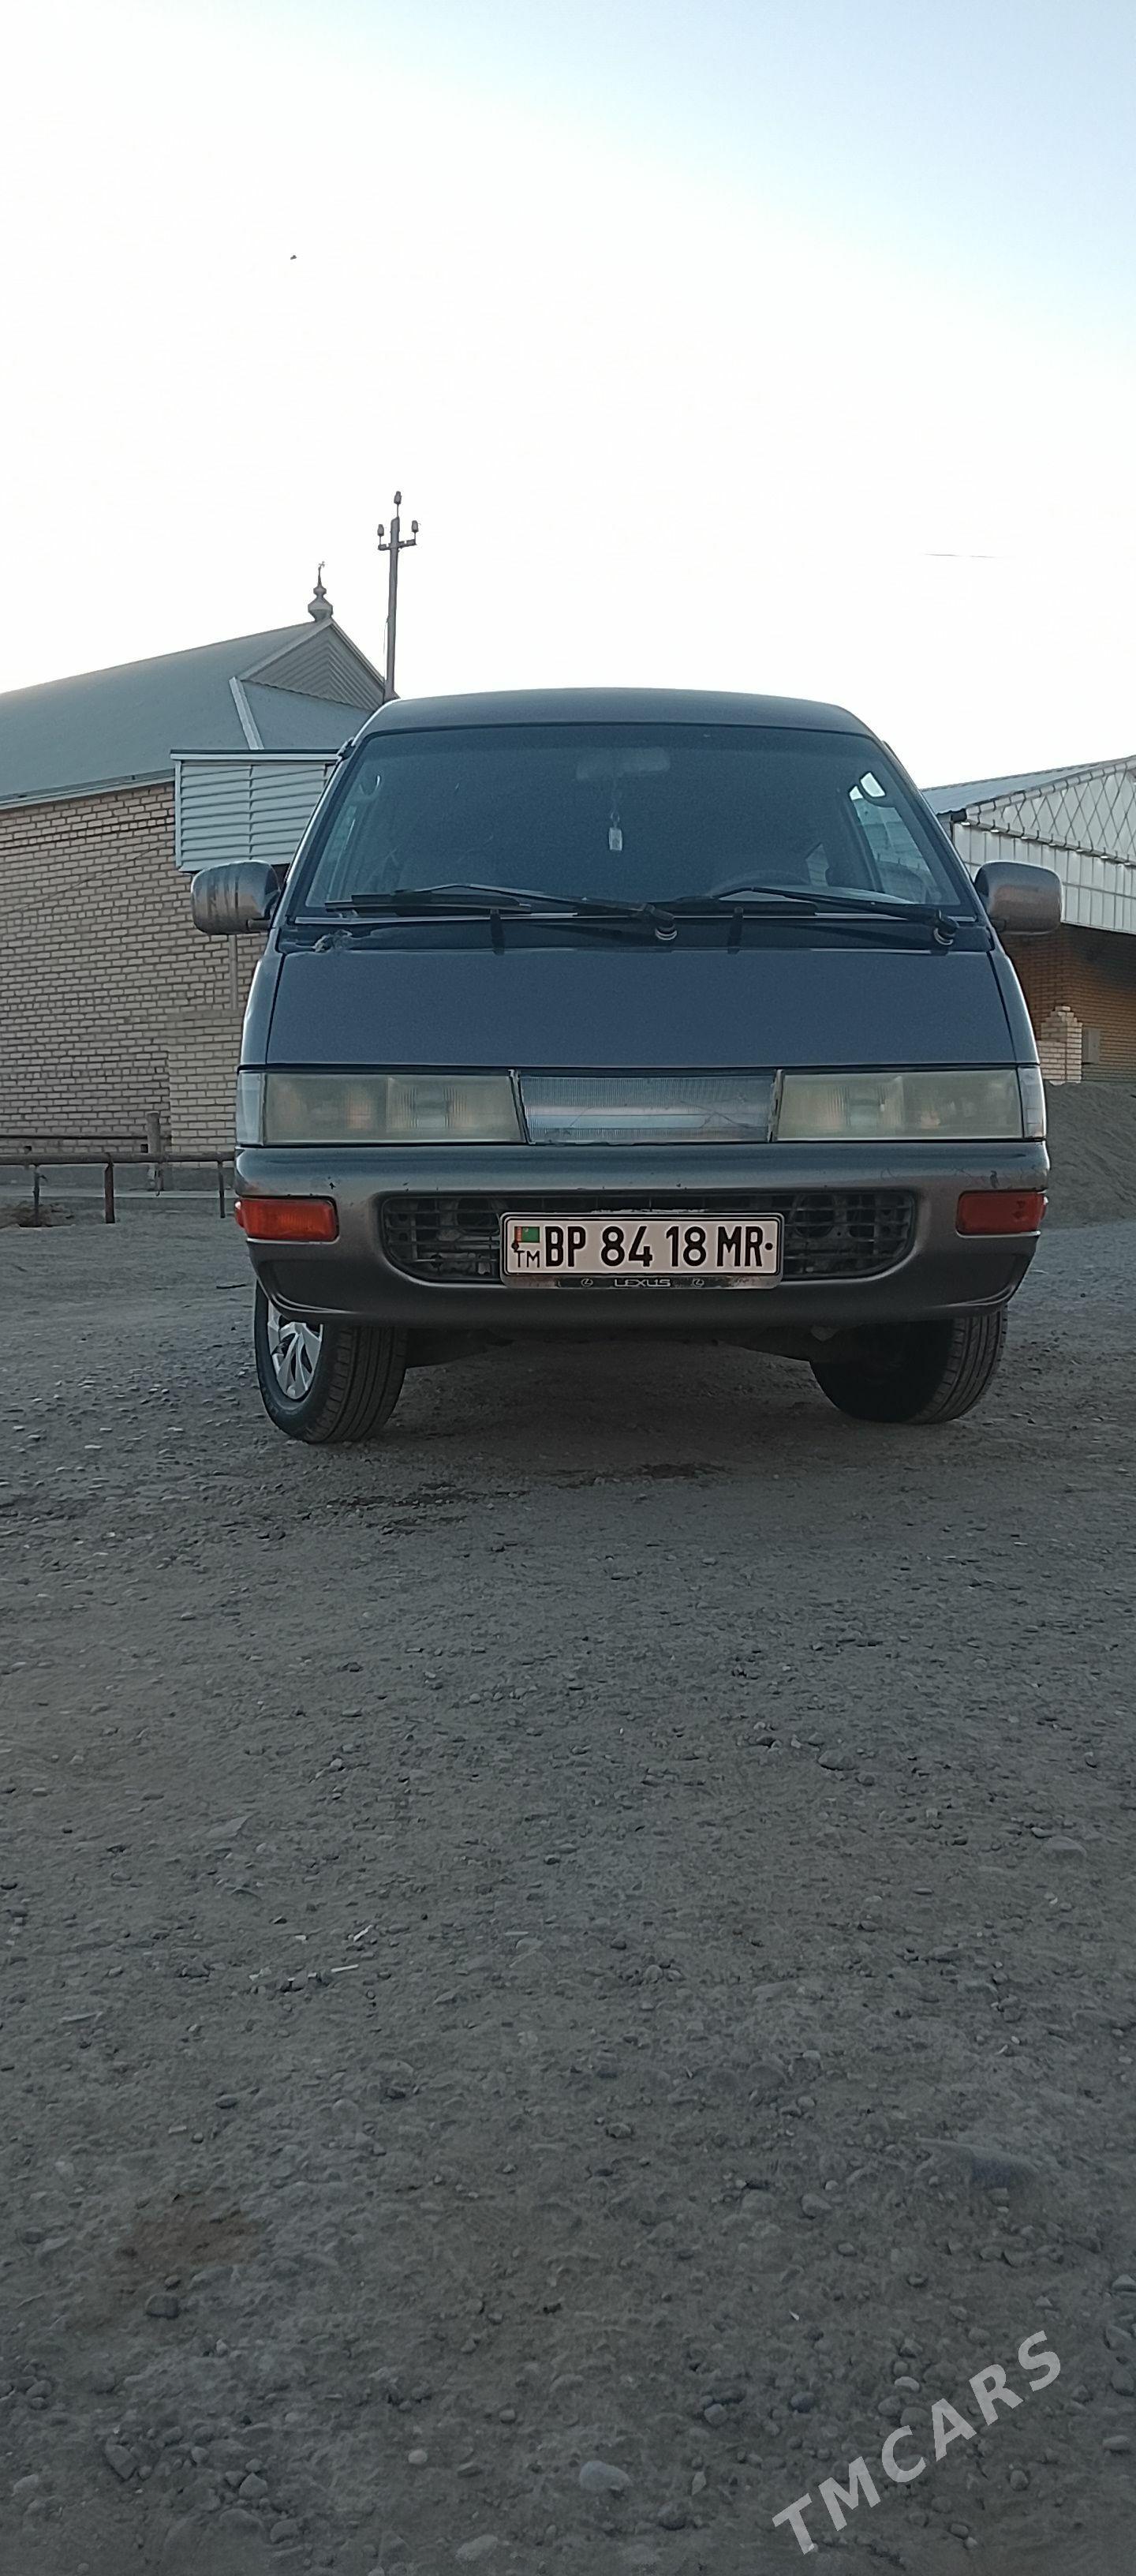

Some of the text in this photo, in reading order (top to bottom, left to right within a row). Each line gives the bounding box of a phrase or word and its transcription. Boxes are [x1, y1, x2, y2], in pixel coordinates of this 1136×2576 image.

[544, 1226, 763, 1267] BP 84 18 MR
[517, 1250, 540, 1267] TM
[614, 1279, 671, 1287] LEXUS
